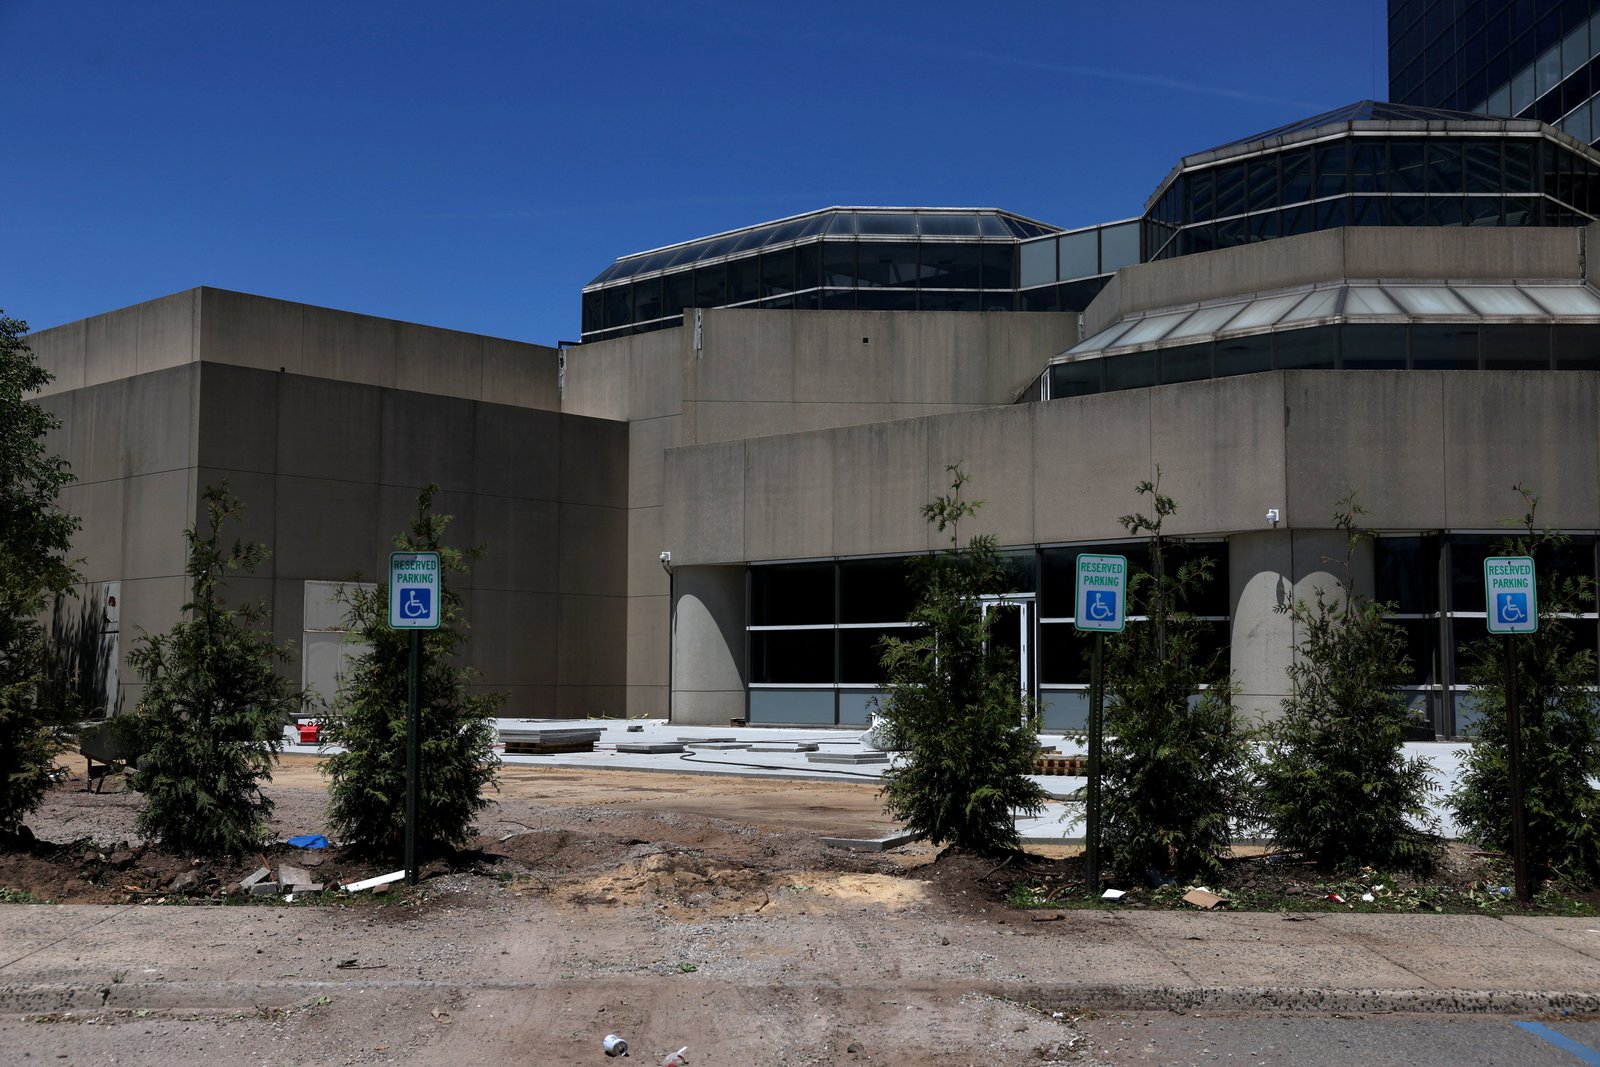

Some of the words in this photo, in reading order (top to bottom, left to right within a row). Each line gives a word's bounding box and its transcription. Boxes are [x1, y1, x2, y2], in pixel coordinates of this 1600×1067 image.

[393, 560, 437, 570] RESERVED
[1080, 562, 1123, 573] RESERVED
[1488, 565, 1531, 575] RESERVED
[397, 573, 434, 583] PARKING
[1083, 575, 1119, 587] PARKING
[1492, 578, 1529, 588] PARKING
